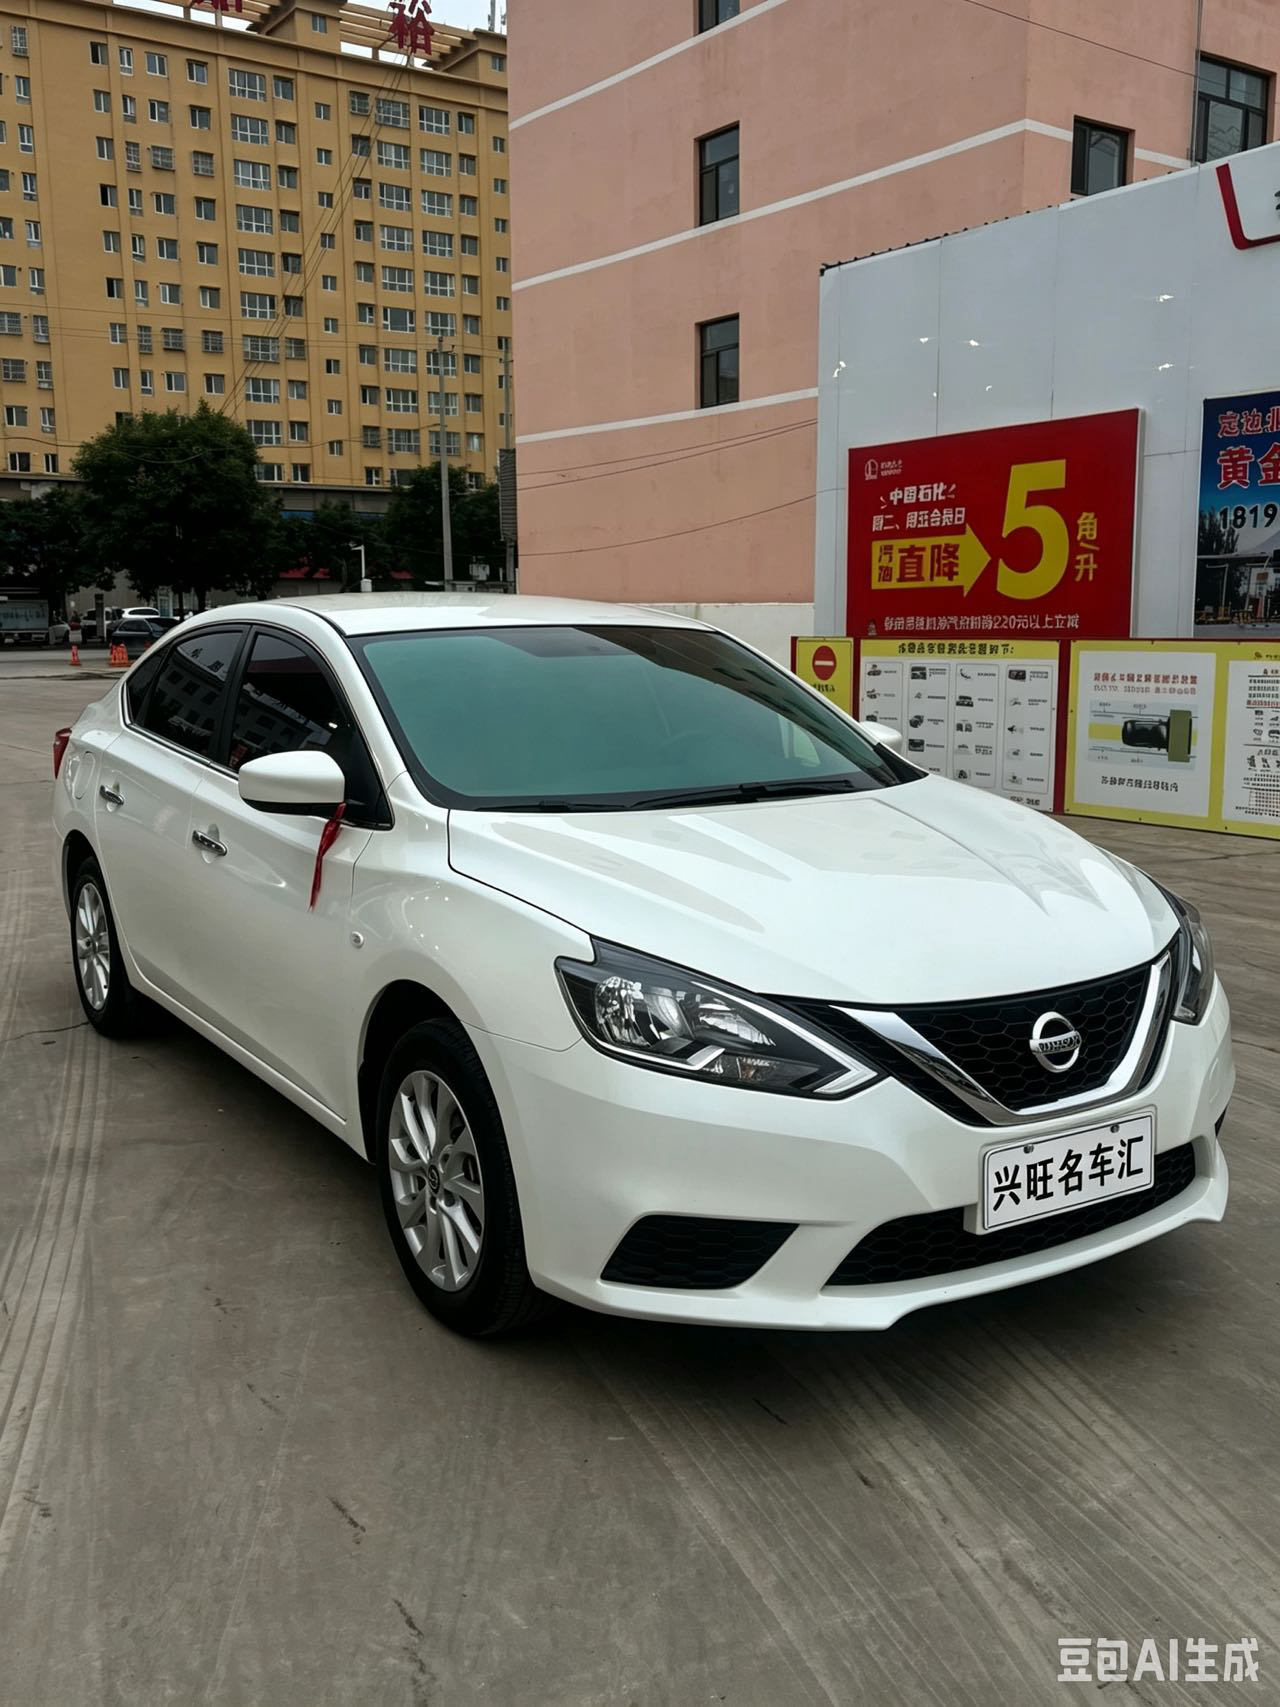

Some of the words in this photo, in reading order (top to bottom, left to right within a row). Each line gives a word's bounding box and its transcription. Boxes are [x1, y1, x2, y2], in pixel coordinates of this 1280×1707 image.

[896, 543, 960, 582] 直降
[996, 458, 1070, 600] 5
[992, 1135, 1144, 1212] 兴旺名车汇
